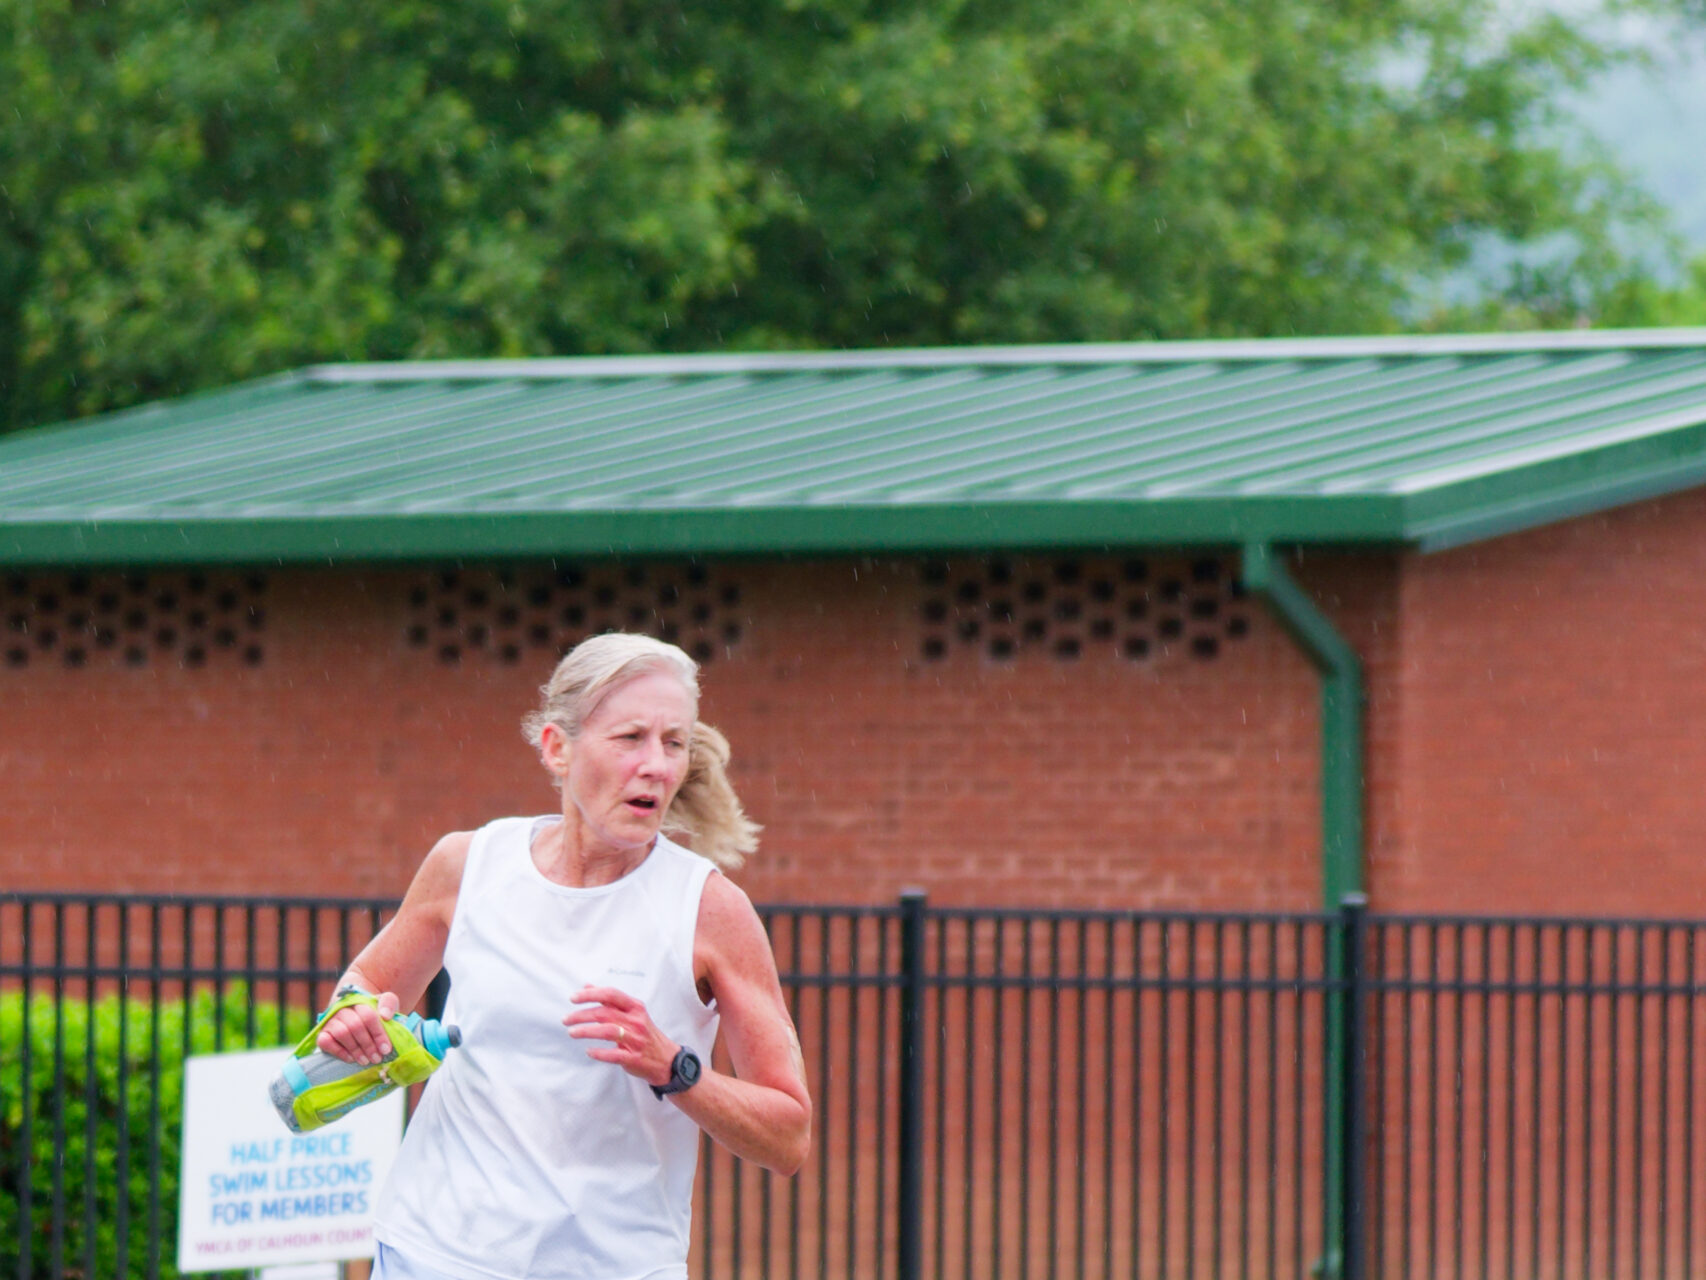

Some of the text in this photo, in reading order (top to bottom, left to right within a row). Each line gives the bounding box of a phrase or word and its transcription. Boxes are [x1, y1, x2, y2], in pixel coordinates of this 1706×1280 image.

[231, 1134, 352, 1164] HALF PRICE
[210, 1161, 371, 1197] SWIM LESSONS
[212, 1192, 366, 1225] FOR MEMBERS
[196, 1241, 233, 1254] YMCA
[237, 1238, 254, 1251] OF
[259, 1232, 322, 1249] CALHOUN
